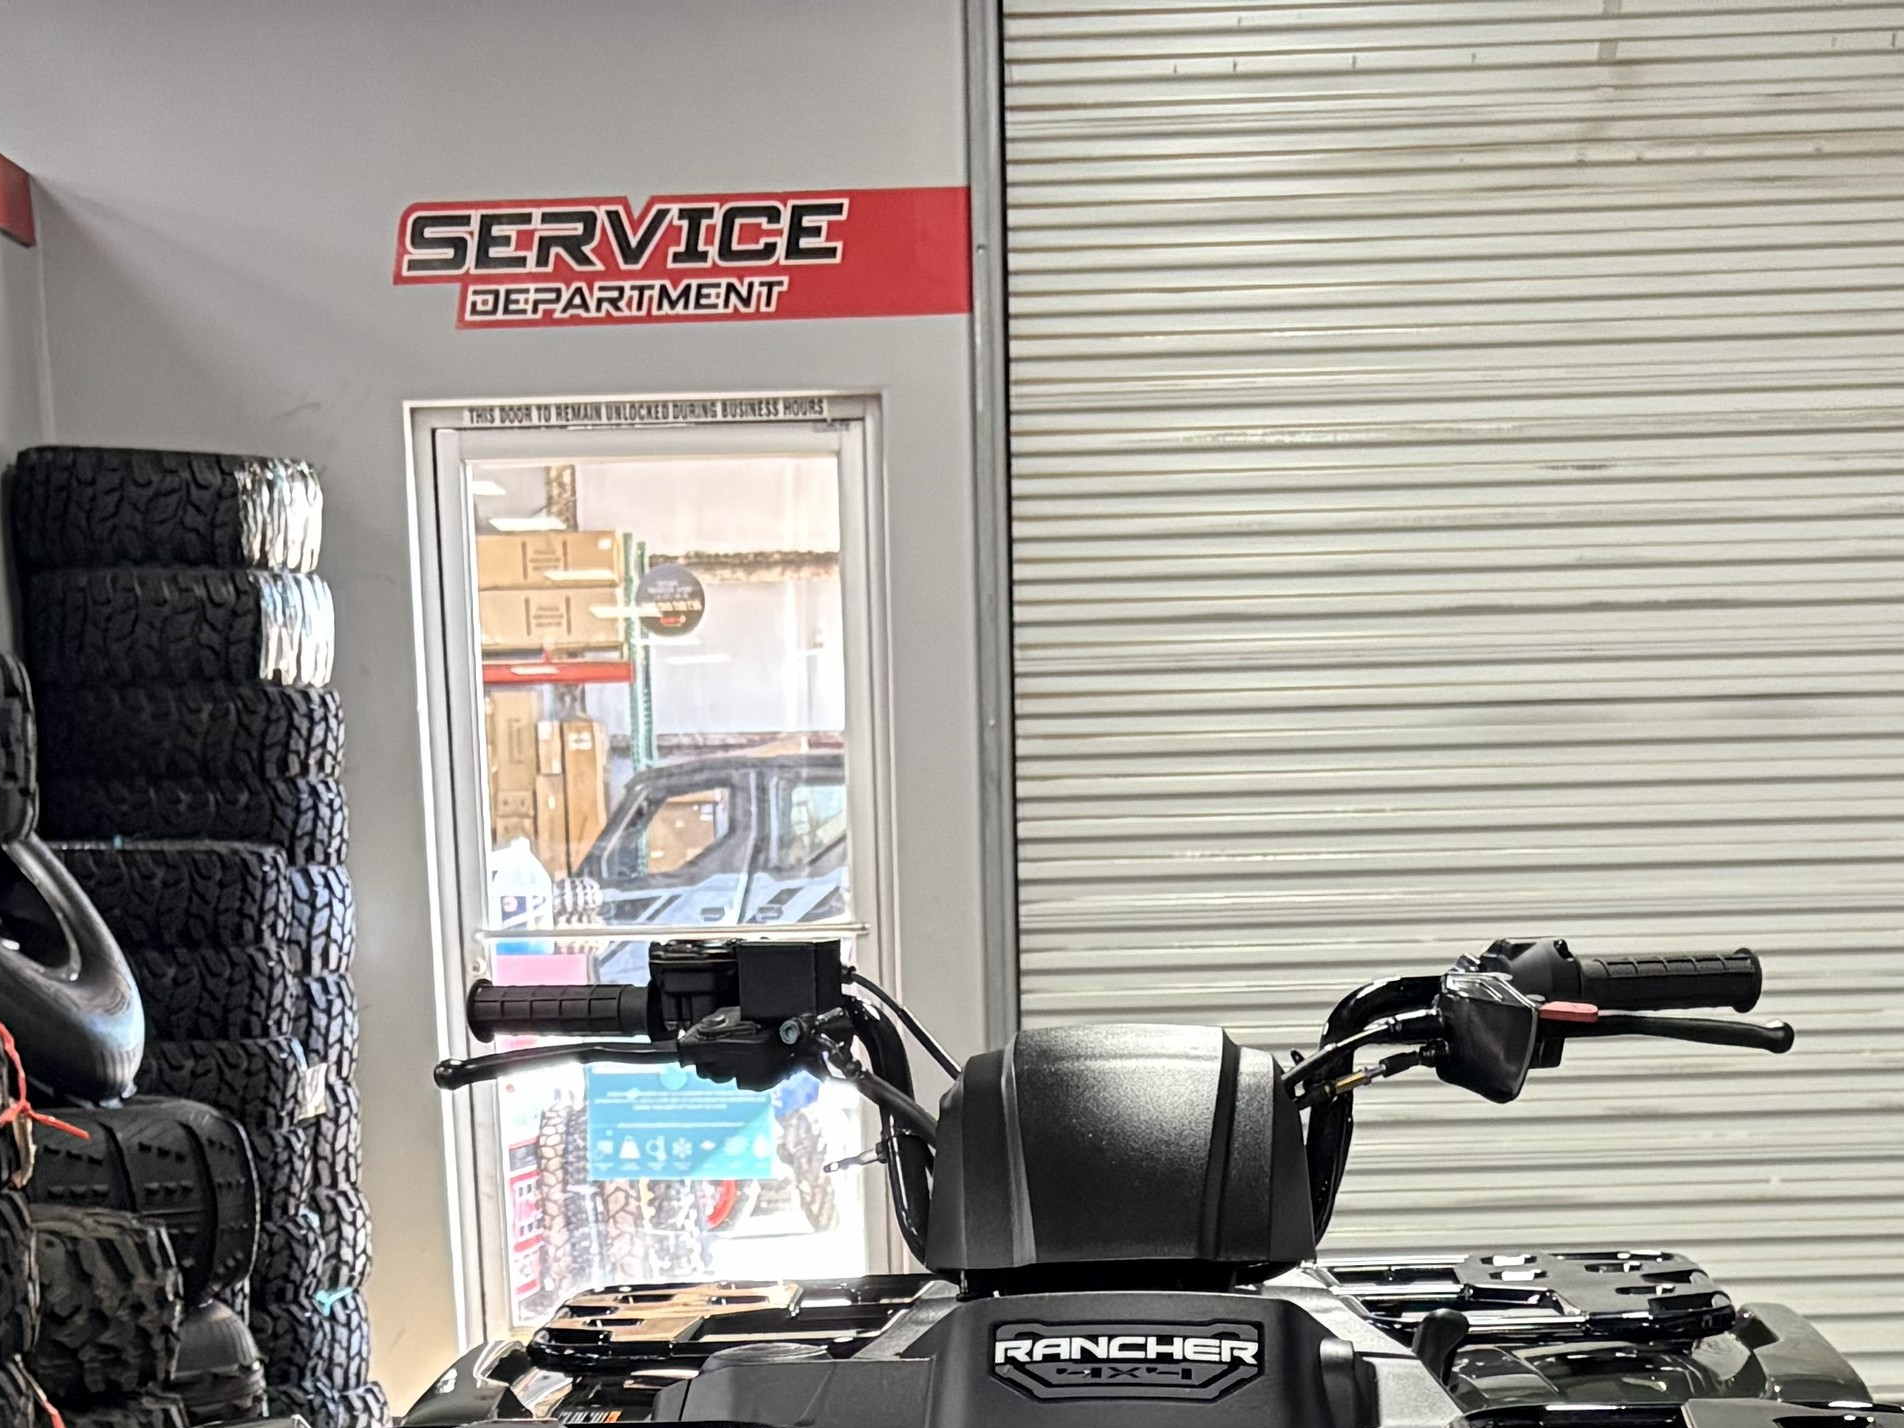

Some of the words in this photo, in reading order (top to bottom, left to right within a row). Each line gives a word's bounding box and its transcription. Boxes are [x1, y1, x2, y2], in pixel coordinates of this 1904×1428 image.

[402, 199, 848, 276] SERVICE
[466, 277, 788, 319] DEPARTMENT
[468, 407, 495, 424] THIS
[500, 407, 532, 423] DOOR
[535, 406, 551, 423] TO
[556, 404, 602, 422] REMAIN
[605, 403, 669, 421] UNLOCKED
[673, 402, 717, 420] DURING
[721, 400, 779, 418] BUSINESS
[783, 398, 824, 416] HOURS
[994, 1336, 1259, 1365] RANCHER
